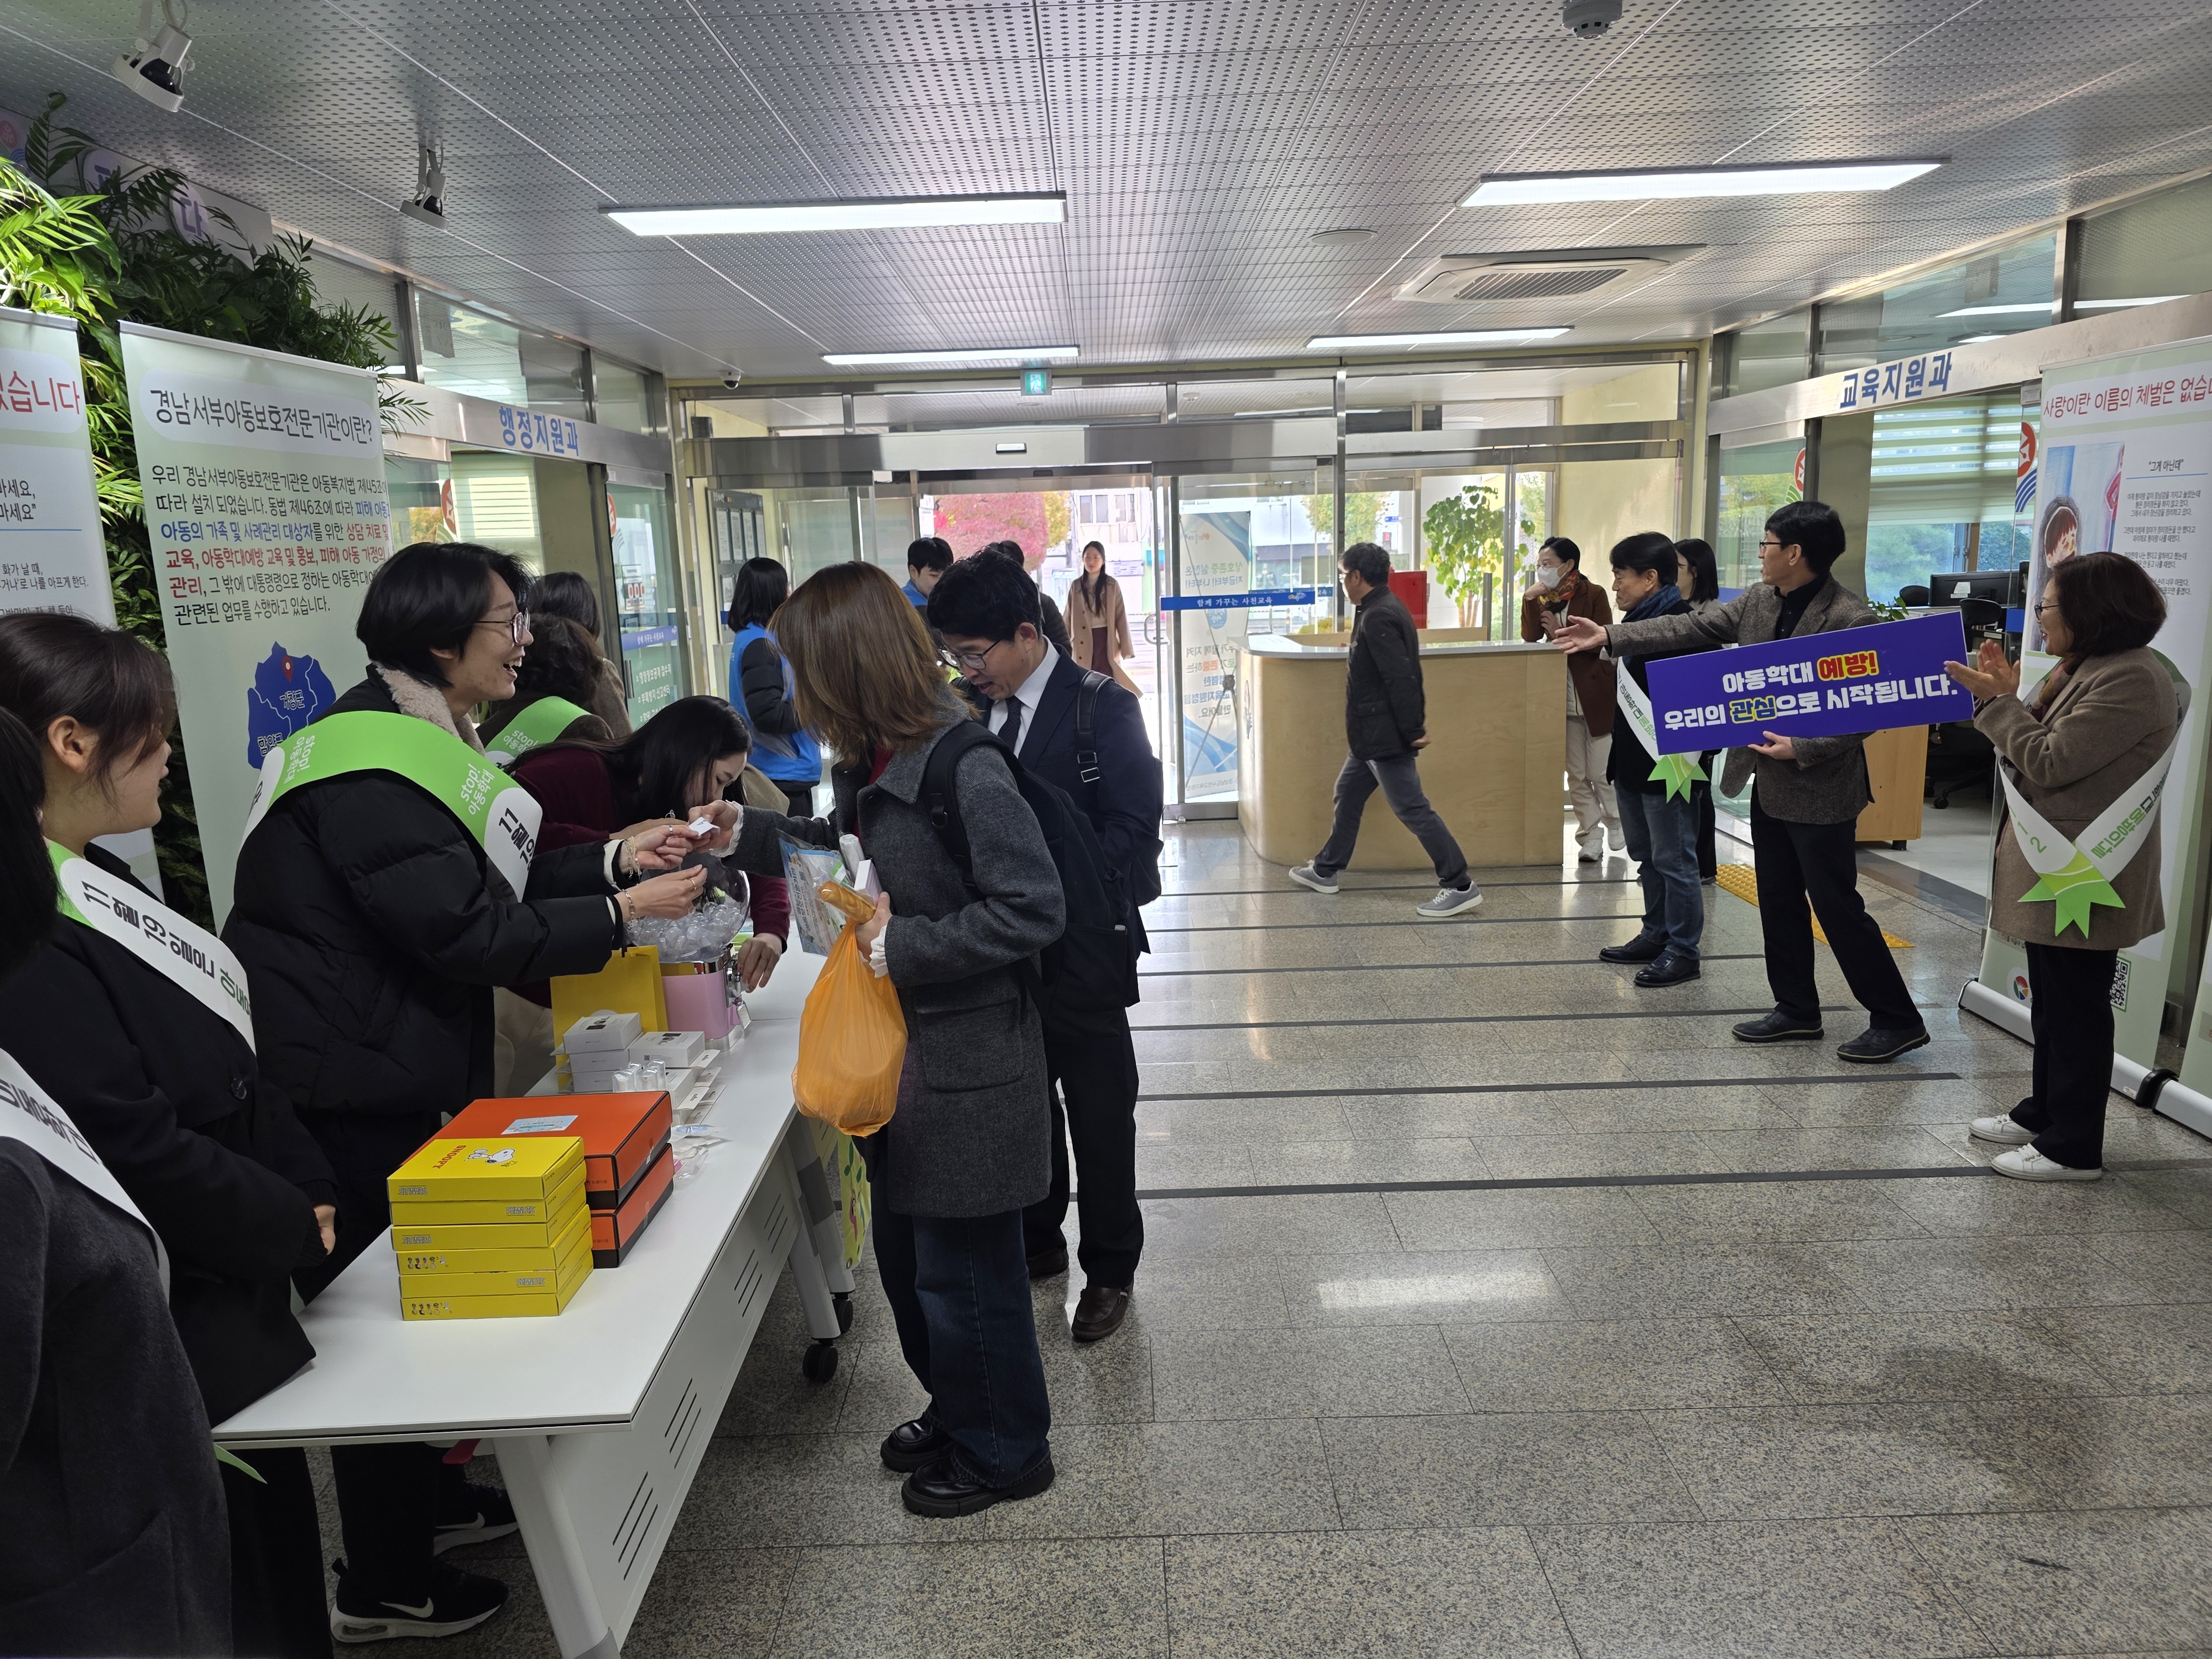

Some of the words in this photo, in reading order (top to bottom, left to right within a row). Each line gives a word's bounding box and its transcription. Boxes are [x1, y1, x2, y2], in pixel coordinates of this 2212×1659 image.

[1840, 352, 1952, 409] 교육지원과
[0, 371, 80, 415] 습니다
[2043, 392, 2091, 418] 사랑이란
[2095, 387, 2133, 411] 이름의
[2136, 380, 2175, 406] 체벌은
[499, 405, 580, 456] 행정지원과
[152, 465, 180, 484] 우리
[182, 466, 310, 492] 경남서부아동보호전문기관은
[312, 475, 356, 494] 아동복지법
[156, 493, 187, 513] 따라
[192, 493, 214, 515] 설치
[216, 495, 268, 516] 되었습니다.
[269, 497, 287, 517] 동법
[289, 498, 333, 516] 제46조에
[335, 500, 353, 517] 따라
[355, 500, 374, 517] 피해
[160, 521, 204, 542] 아동의
[206, 521, 228, 541] 가족
[229, 521, 242, 542] 및
[244, 521, 281, 542] 사례관리
[283, 522, 323, 542] 대상자를
[325, 523, 344, 541] 위한
[347, 523, 364, 541] 상담
[366, 523, 382, 540] 치료
[382, 523, 390, 541] 및
[2, 563, 19, 576] 화가
[21, 563, 29, 576] 날
[32, 562, 43, 576] 때,
[165, 549, 200, 570] 교육,
[201, 547, 264, 569] 아동학대예방
[266, 547, 284, 567] 교육
[284, 547, 296, 567] 및
[296, 546, 319, 566] 홍보,
[319, 546, 340, 564] 피해
[342, 546, 360, 564] 아동
[361, 546, 386, 564] 가정의
[0, 577, 29, 591] 거나'로
[29, 577, 46, 590] 나를
[48, 576, 71, 589] 아프게
[71, 575, 89, 588] 한다.
[169, 576, 207, 598] 관리,
[209, 577, 221, 593] 그
[222, 575, 246, 595] 밖에
[247, 573, 300, 593] 대통령령으로
[301, 571, 330, 591] 정하는
[174, 602, 220, 626] 관련된
[222, 600, 252, 623] 업무를
[254, 598, 289, 619] 수행하고
[290, 595, 331, 617] 있습니다.
[1197, 598, 1213, 608] 함께
[1215, 597, 1239, 607] 가꾸는
[1241, 594, 1273, 607] 사천교육
[1721, 661, 1814, 694] 아동학대
[1817, 650, 1880, 682] 예방!
[280, 690, 305, 710] 거창군
[1664, 702, 1726, 731] 우리의
[1729, 691, 1821, 724] 관심으로
[1827, 674, 1958, 710] 시작됩니다.
[503, 735, 527, 753] 아동학
[512, 730, 539, 747] stop!
[283, 737, 305, 785] 아동학대
[296, 735, 316, 773] stop!
[460, 763, 482, 802] stop!
[468, 768, 495, 815] 아동학대
[432, 1145, 467, 1169] SNOOPY
[398, 1186, 427, 1195] PEANUTS
[506, 1206, 535, 1214] PEANUTS
[402, 1235, 432, 1244] PEANUTS
[515, 1277, 545, 1286] PEANUTS
